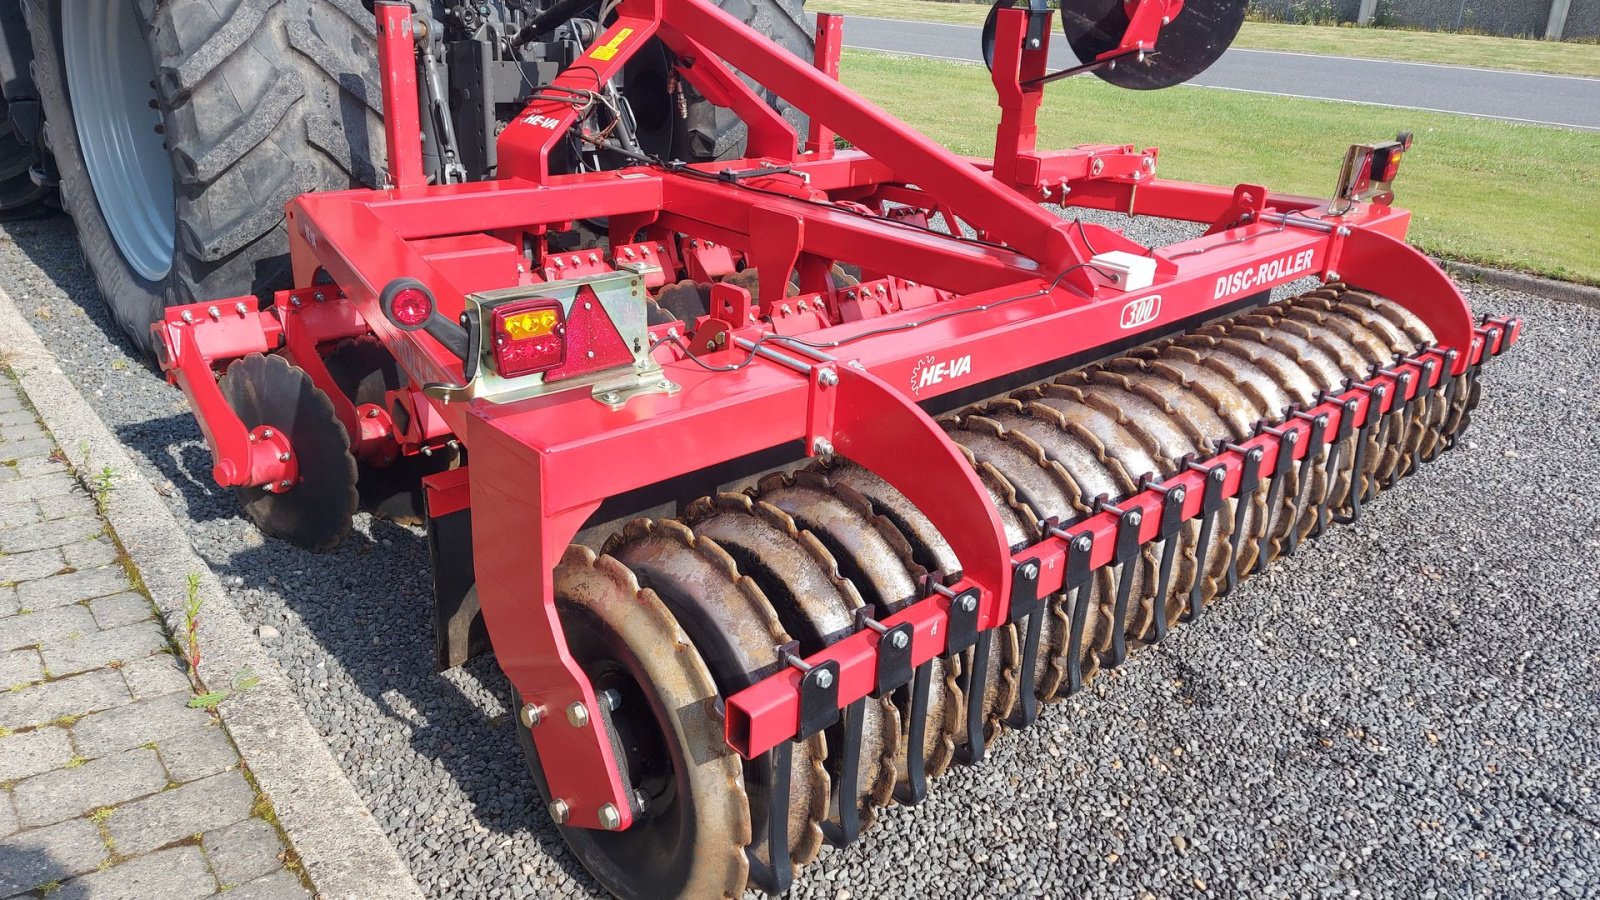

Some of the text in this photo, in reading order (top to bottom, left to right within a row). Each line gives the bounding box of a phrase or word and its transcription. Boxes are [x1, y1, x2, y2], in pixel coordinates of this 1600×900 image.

[524, 114, 560, 130] HE-VA
[1213, 248, 1314, 300] DISC-ROLLER
[1125, 297, 1154, 326] 300
[919, 354, 971, 388] HE-VA
